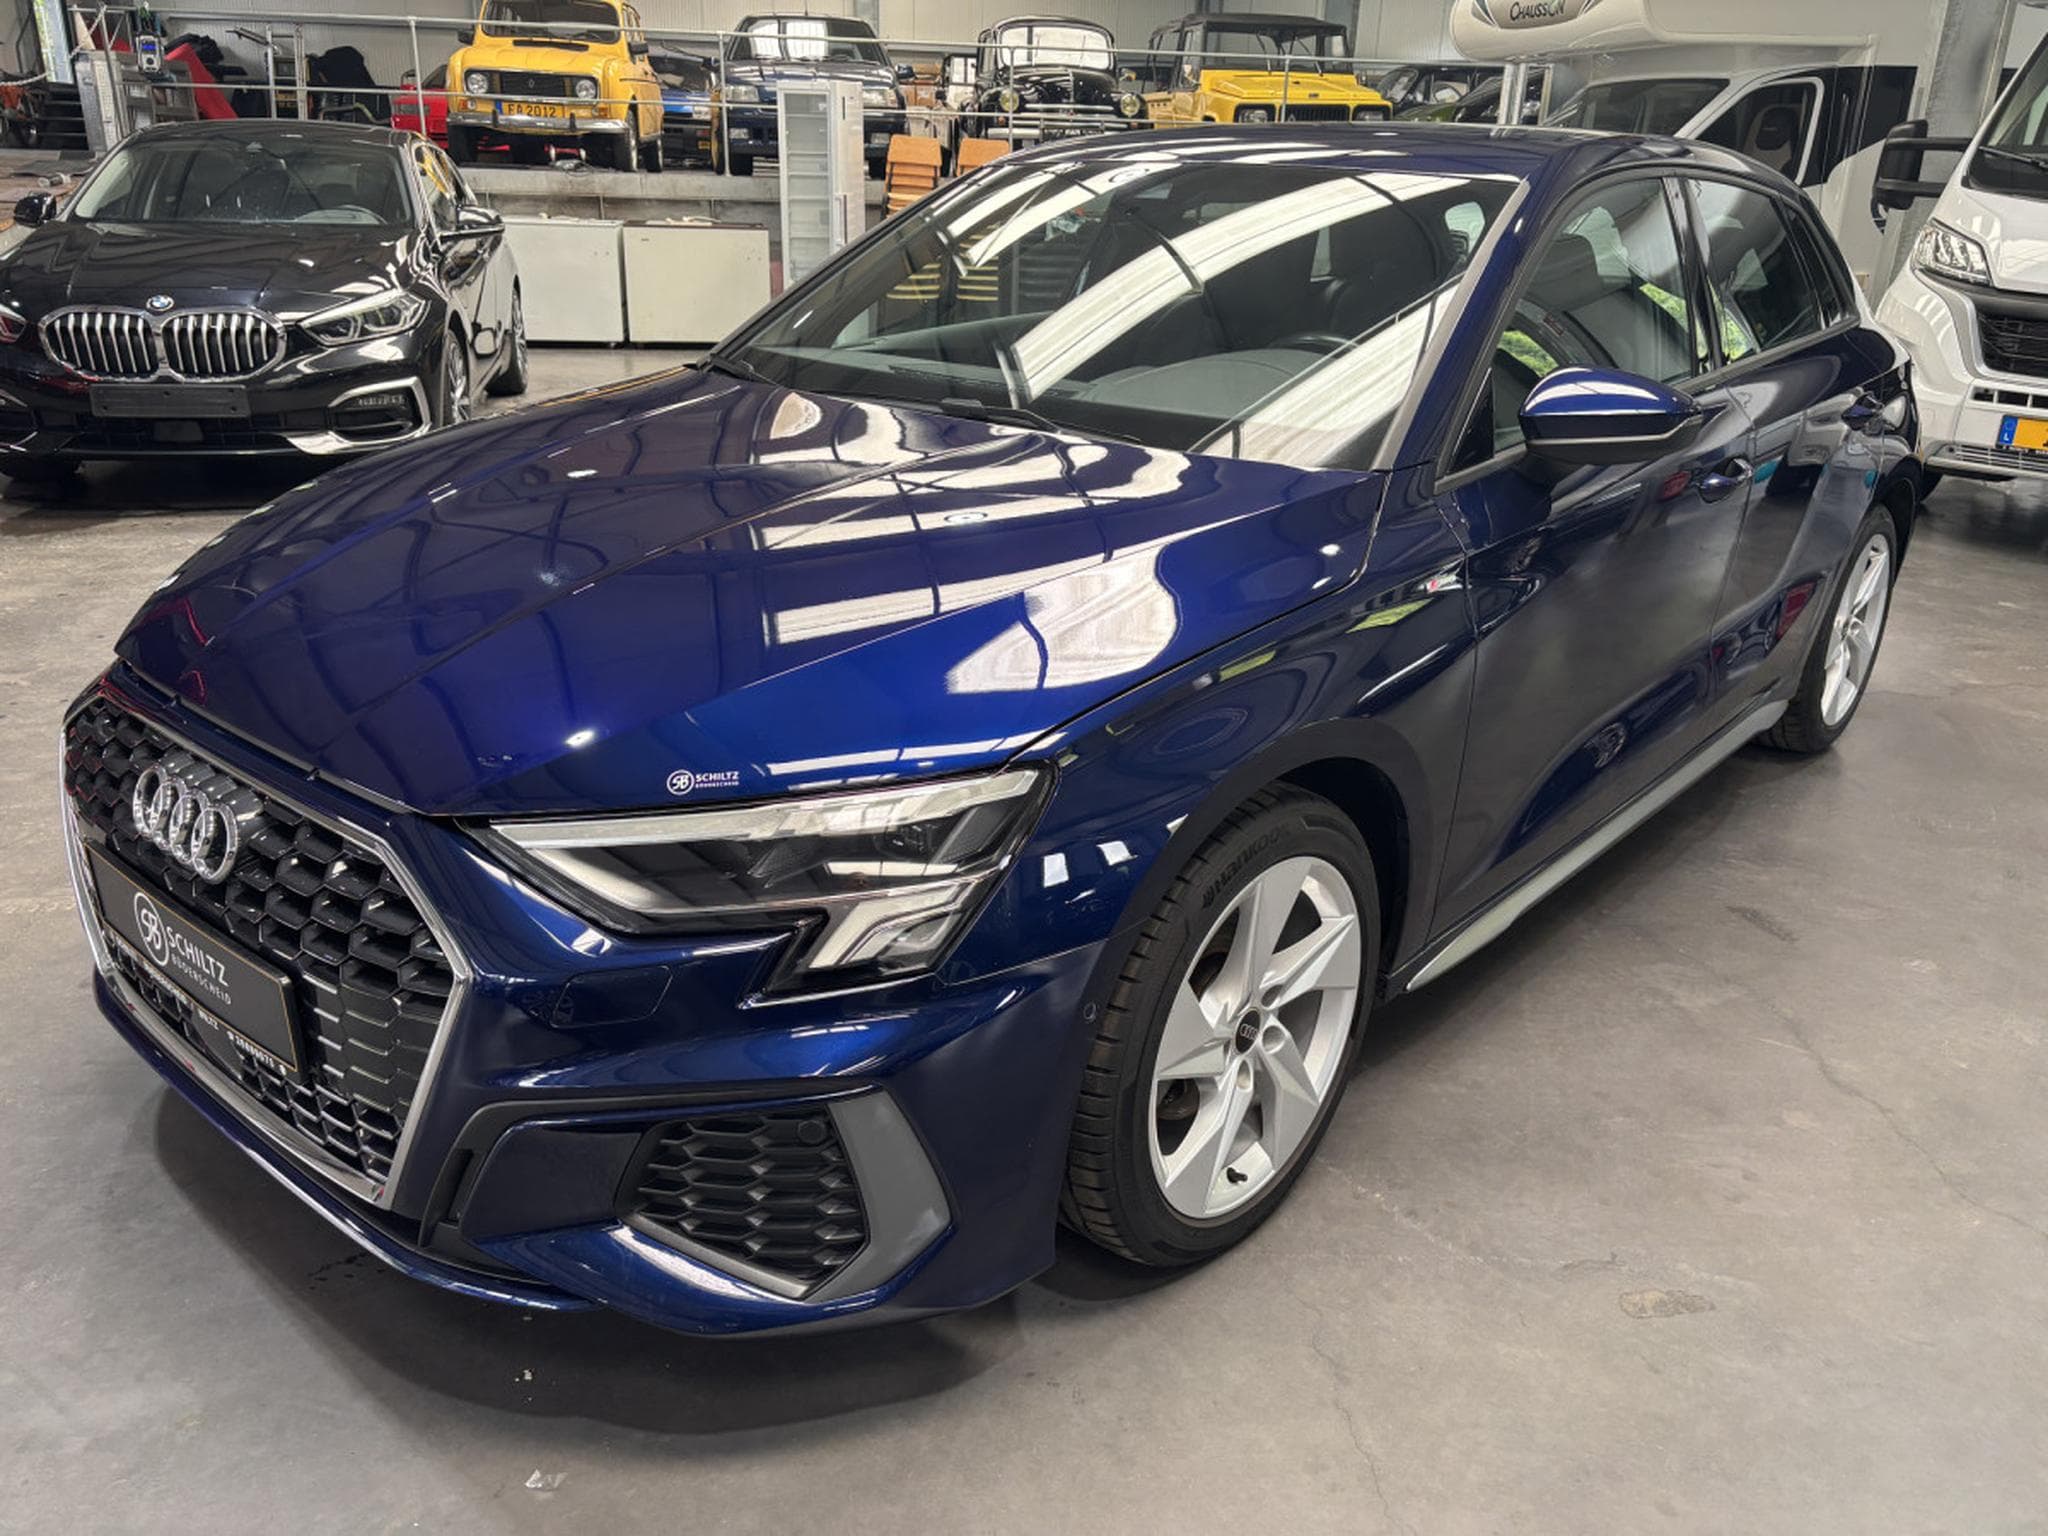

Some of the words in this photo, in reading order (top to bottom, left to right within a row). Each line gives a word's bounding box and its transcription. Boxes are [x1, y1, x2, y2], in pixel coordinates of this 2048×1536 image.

[526, 104, 557, 118] 2012
[695, 771, 739, 782] SCHILTZ
[166, 926, 229, 987] SCHILTZ
